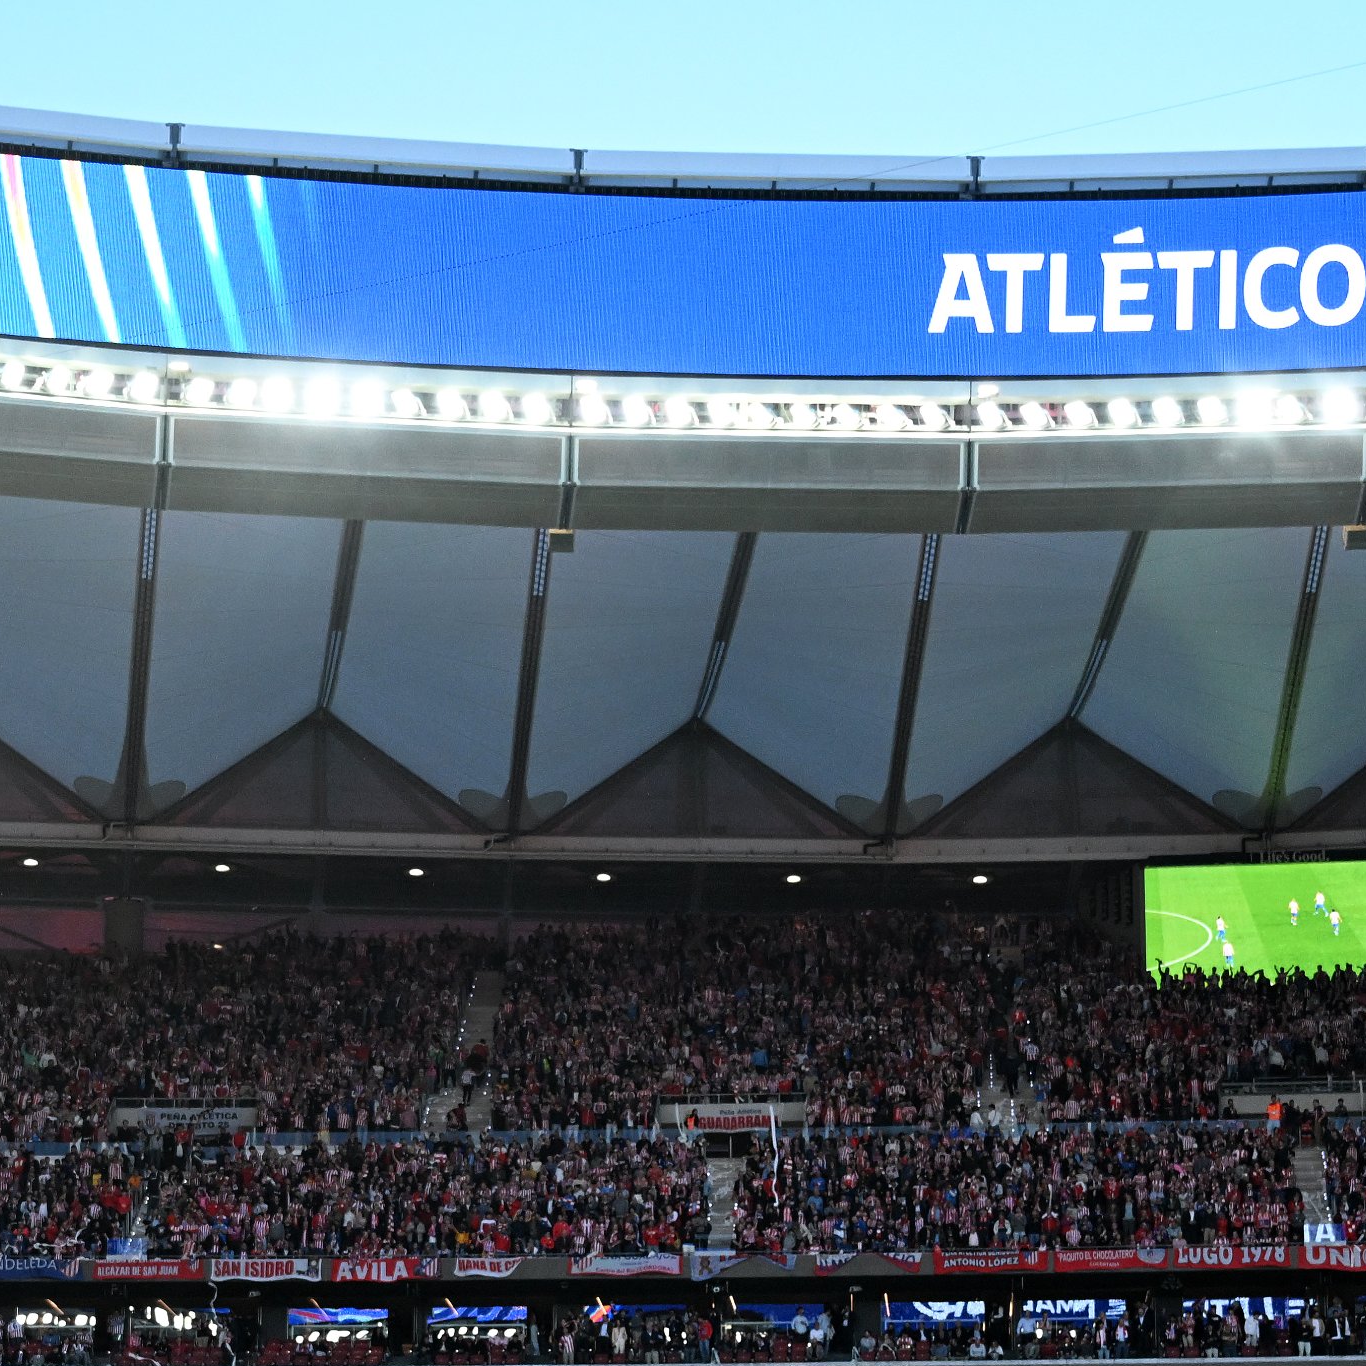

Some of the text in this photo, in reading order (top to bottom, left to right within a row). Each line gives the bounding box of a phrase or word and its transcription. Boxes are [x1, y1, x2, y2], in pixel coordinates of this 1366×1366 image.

[1178, 1245, 1285, 1264] LUGO 1978
[214, 1260, 295, 1277] SAN ISIDRO
[943, 1256, 1020, 1268] ANTONIO LÓPEZ
[132, 1266, 141, 1276] DE
[142, 1265, 157, 1276] SAN
[159, 1265, 179, 1276] JUAN
